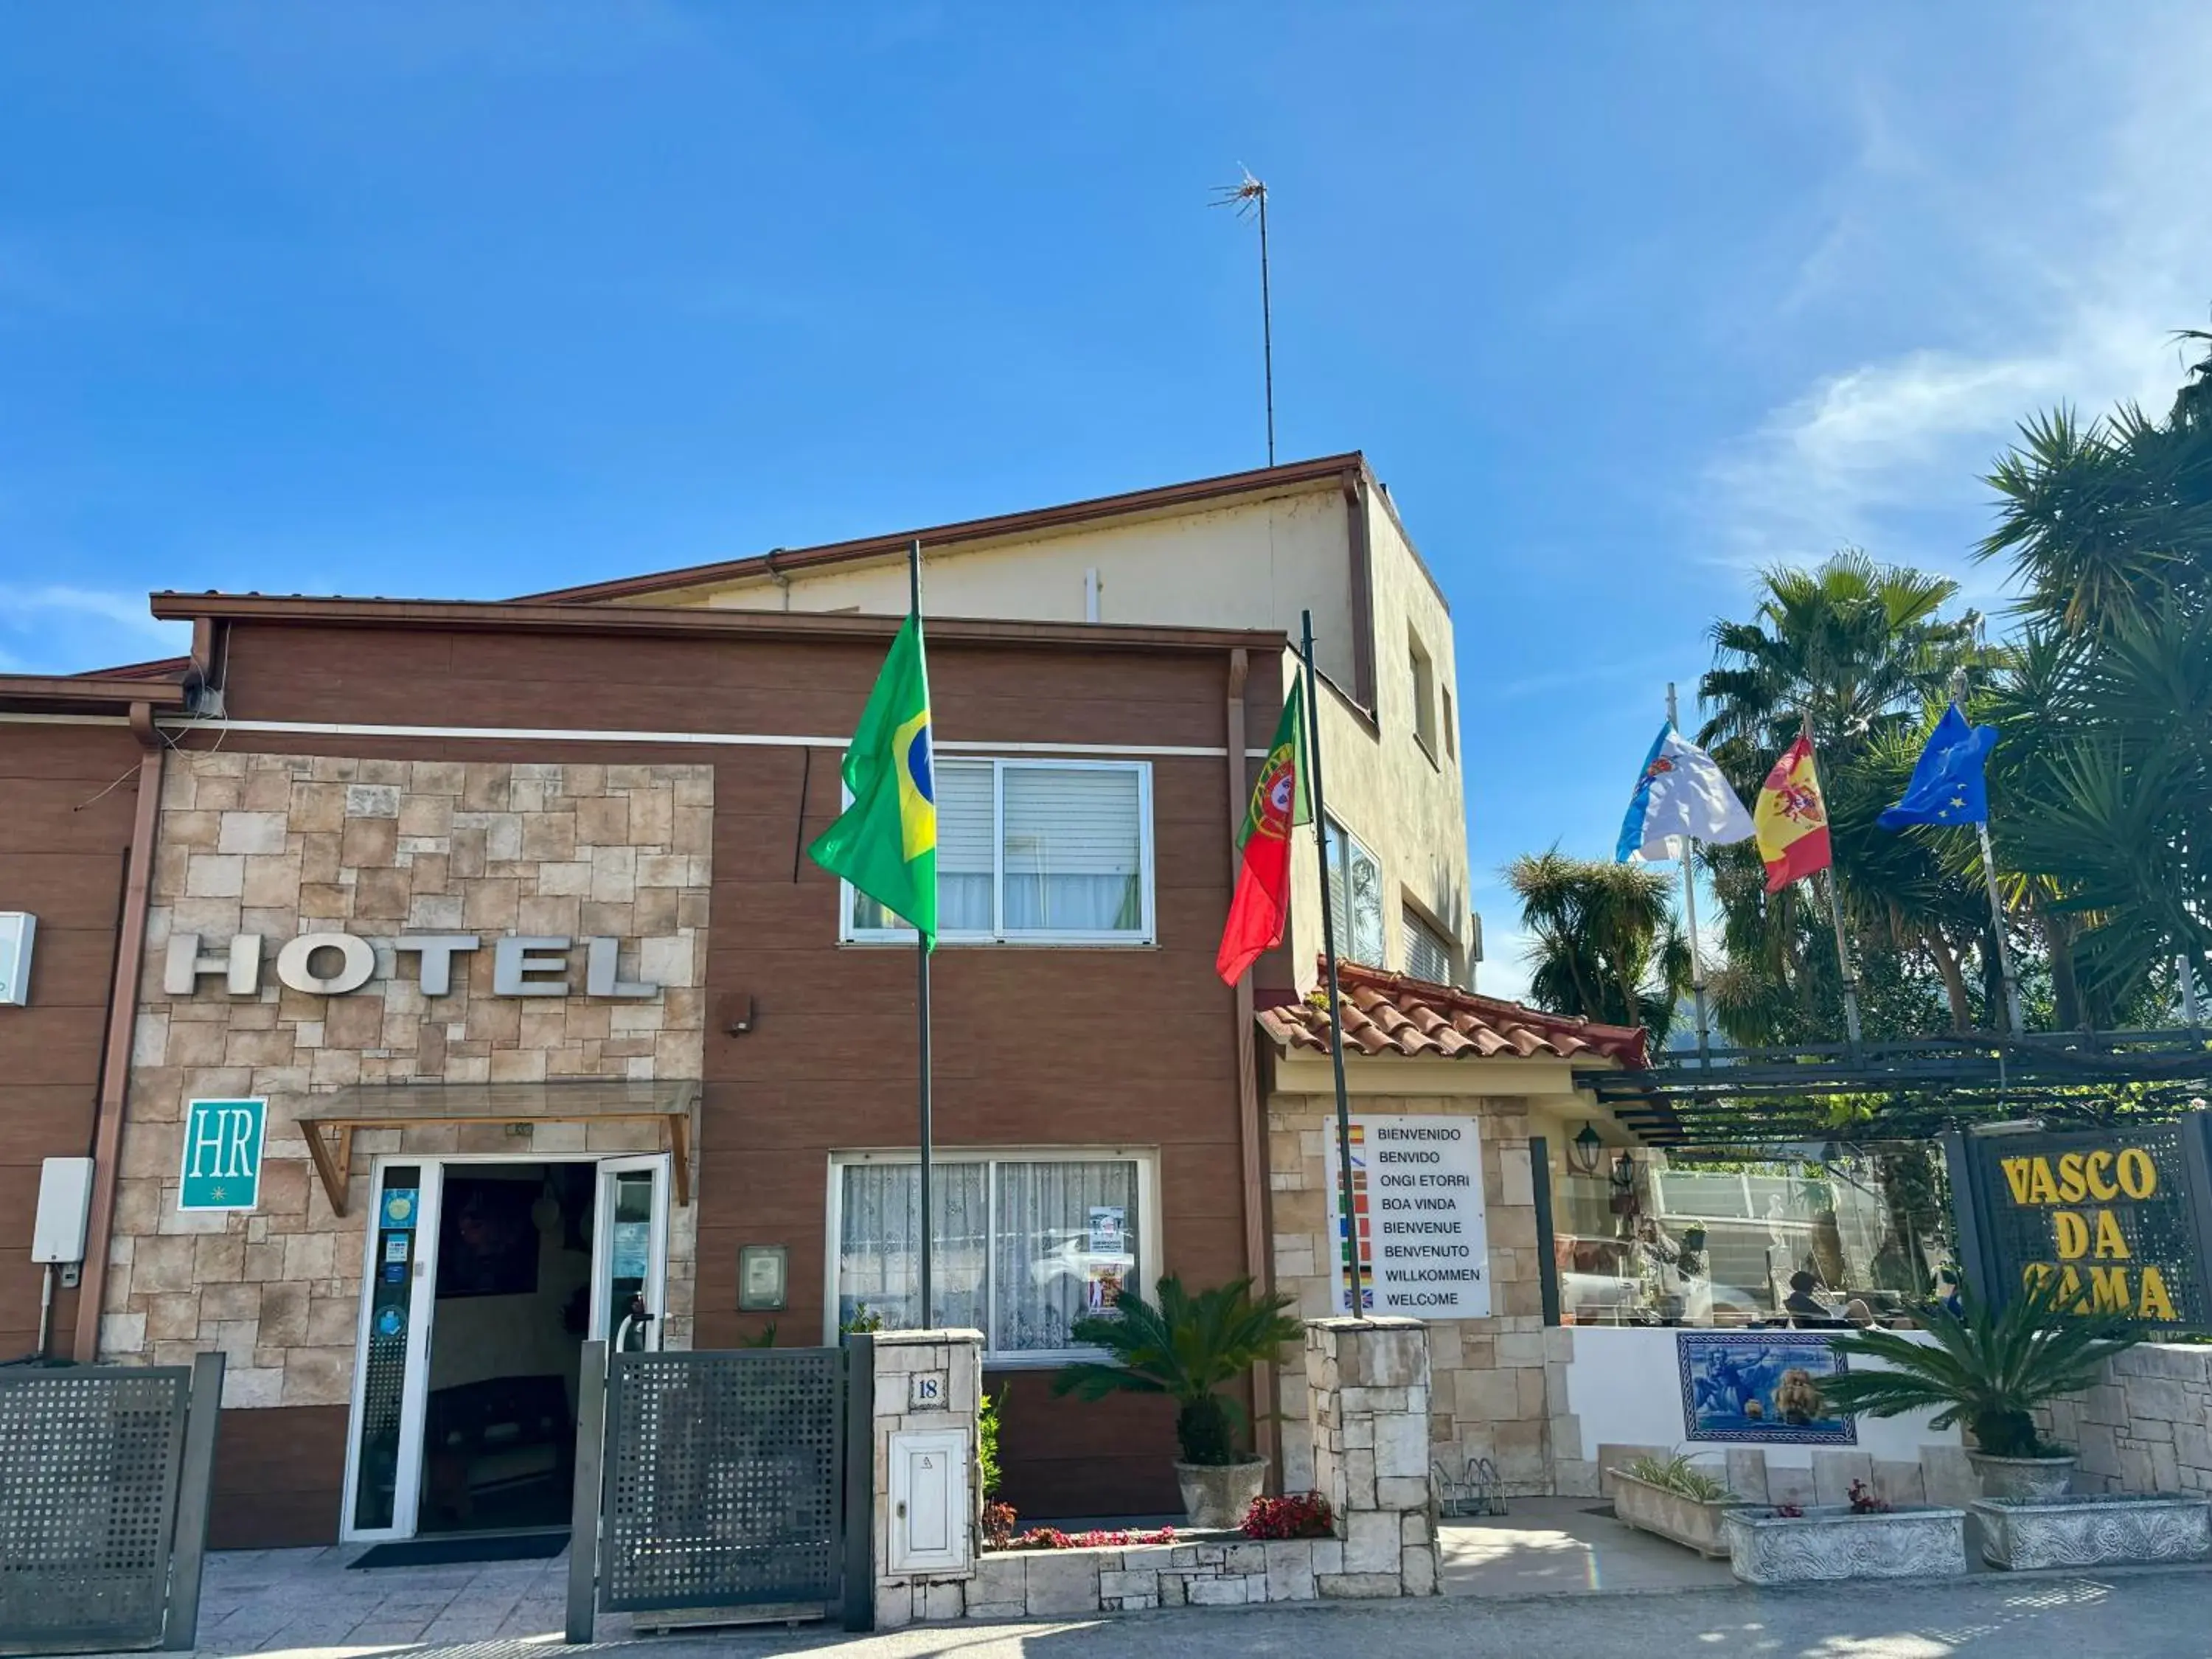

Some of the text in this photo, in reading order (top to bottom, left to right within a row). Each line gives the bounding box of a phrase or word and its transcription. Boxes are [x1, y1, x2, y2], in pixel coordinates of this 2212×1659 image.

[164, 932, 658, 997] HOTEL
[1377, 1128, 1461, 1141] BIENVENIDO
[188, 1109, 254, 1178] HR
[1379, 1151, 1441, 1164] BENVIDO
[1380, 1175, 1470, 1187] ONGI ETORRI
[2000, 1148, 2157, 1204] VASCO
[1382, 1198, 1457, 1211] BOA VINDA
[1383, 1222, 1462, 1234] BIENVENUE
[2053, 1209, 2131, 1259] DA
[1385, 1245, 1470, 1258] BENVENUTO
[1385, 1269, 1481, 1282] WILLKOMMEN
[1387, 1293, 1459, 1306] WELCOME
[919, 1380, 937, 1399] 18
